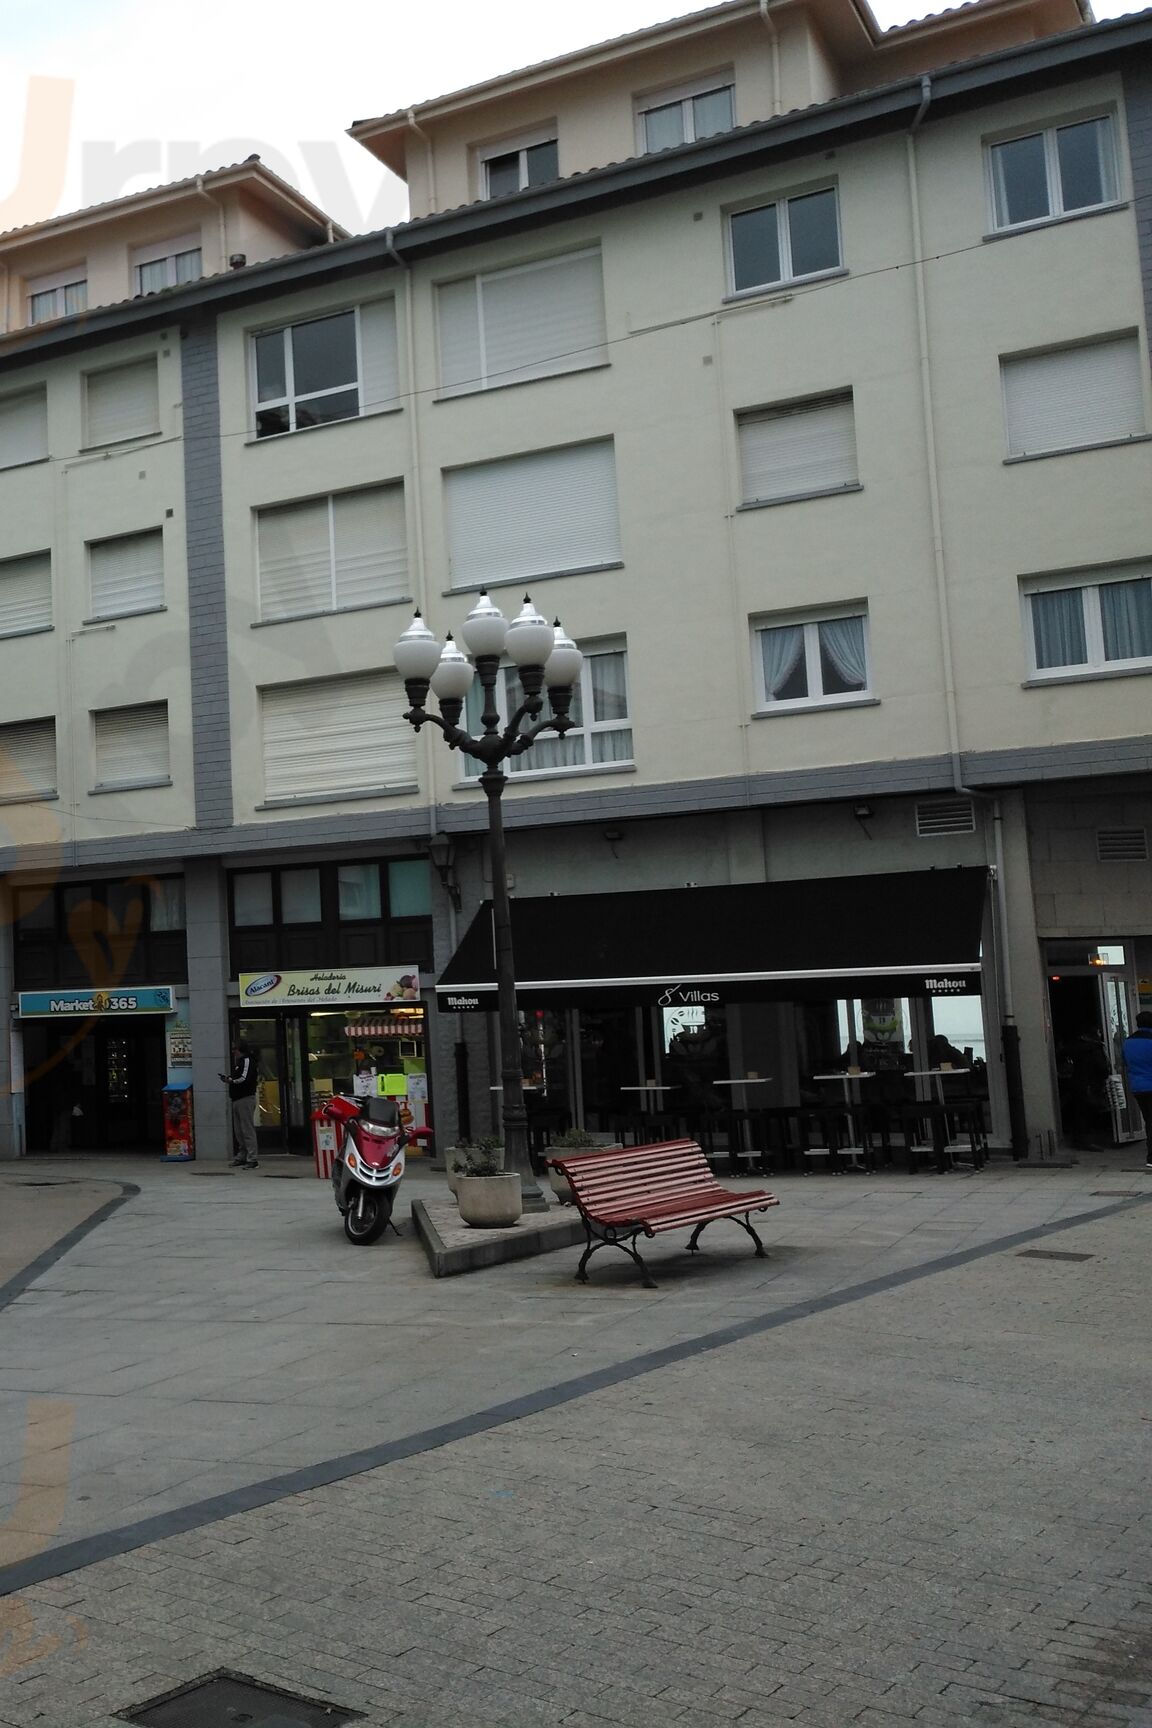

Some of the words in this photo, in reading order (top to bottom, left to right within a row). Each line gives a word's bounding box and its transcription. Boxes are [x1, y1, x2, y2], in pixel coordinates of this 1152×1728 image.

[287, 984, 321, 997] Brisas
[324, 982, 341, 995] del
[344, 981, 383, 995] Misuri
[924, 977, 967, 989] Mahou
[447, 996, 479, 1006] Mahou
[679, 990, 720, 1003] Villas
[50, 997, 94, 1013] Market
[110, 996, 137, 1011] 365
